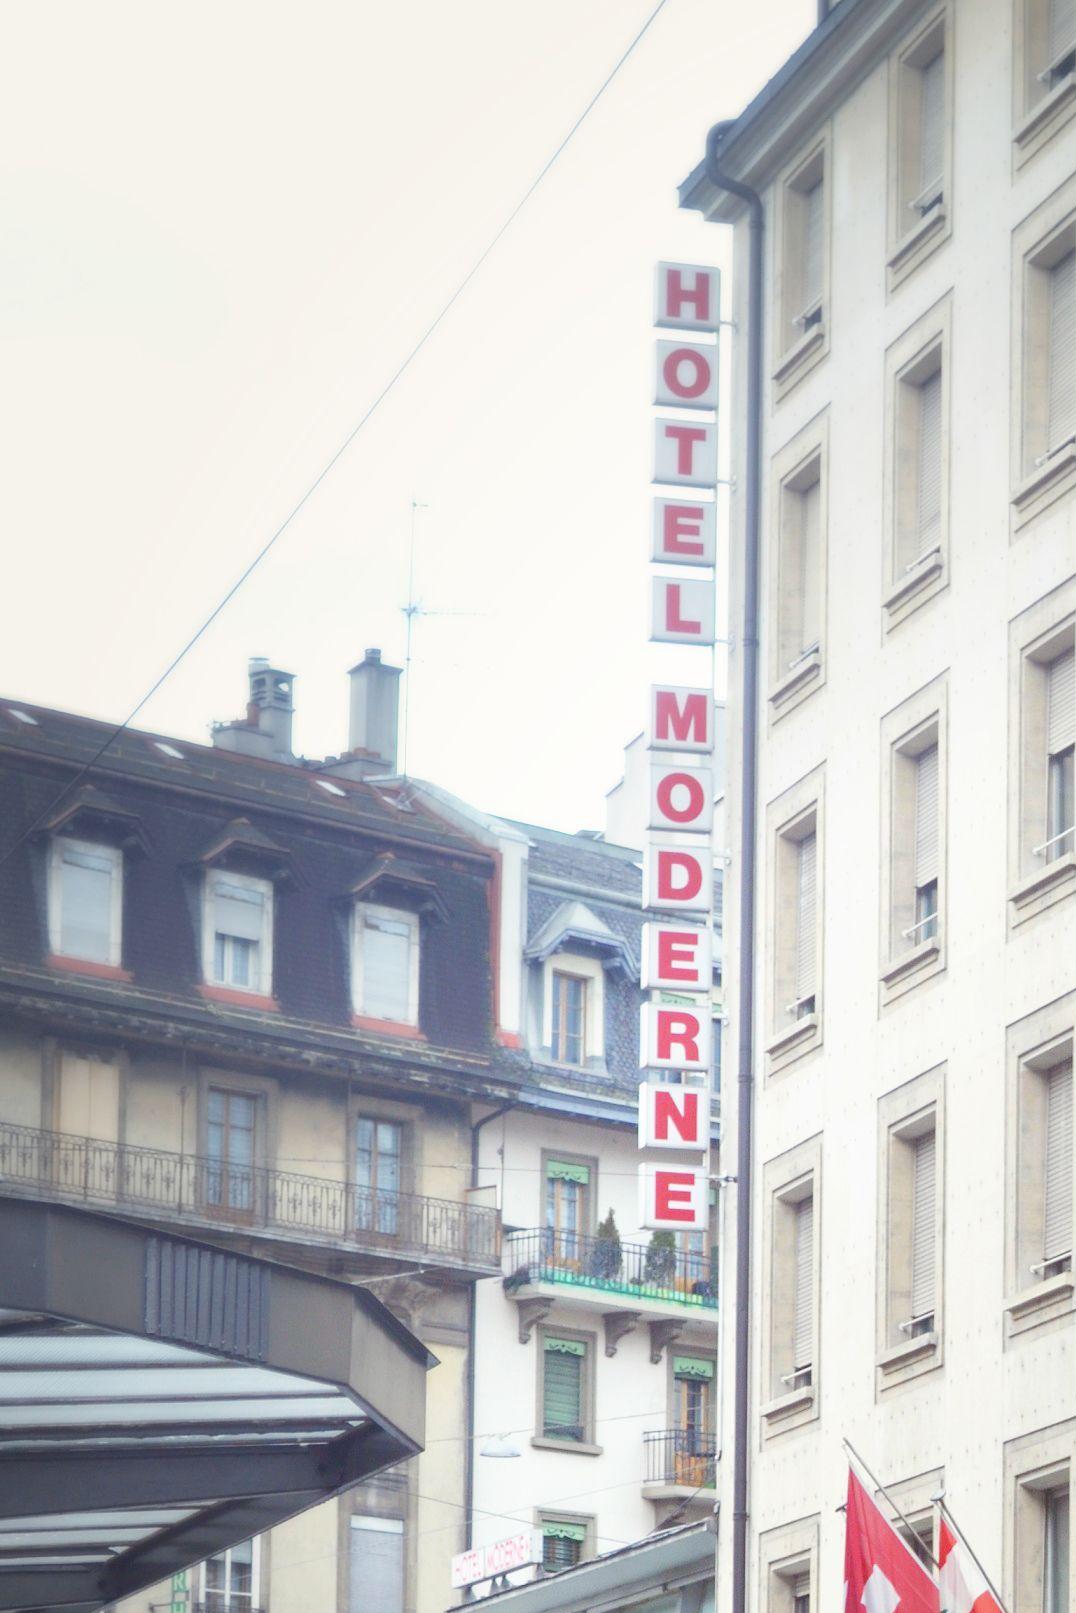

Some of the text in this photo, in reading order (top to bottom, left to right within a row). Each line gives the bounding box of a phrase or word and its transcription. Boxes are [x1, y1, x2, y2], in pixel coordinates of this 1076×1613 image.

[663, 269, 711, 634] HOTEL
[654, 692, 708, 1222] MODERNE
[454, 1551, 481, 1582] HOTEL
